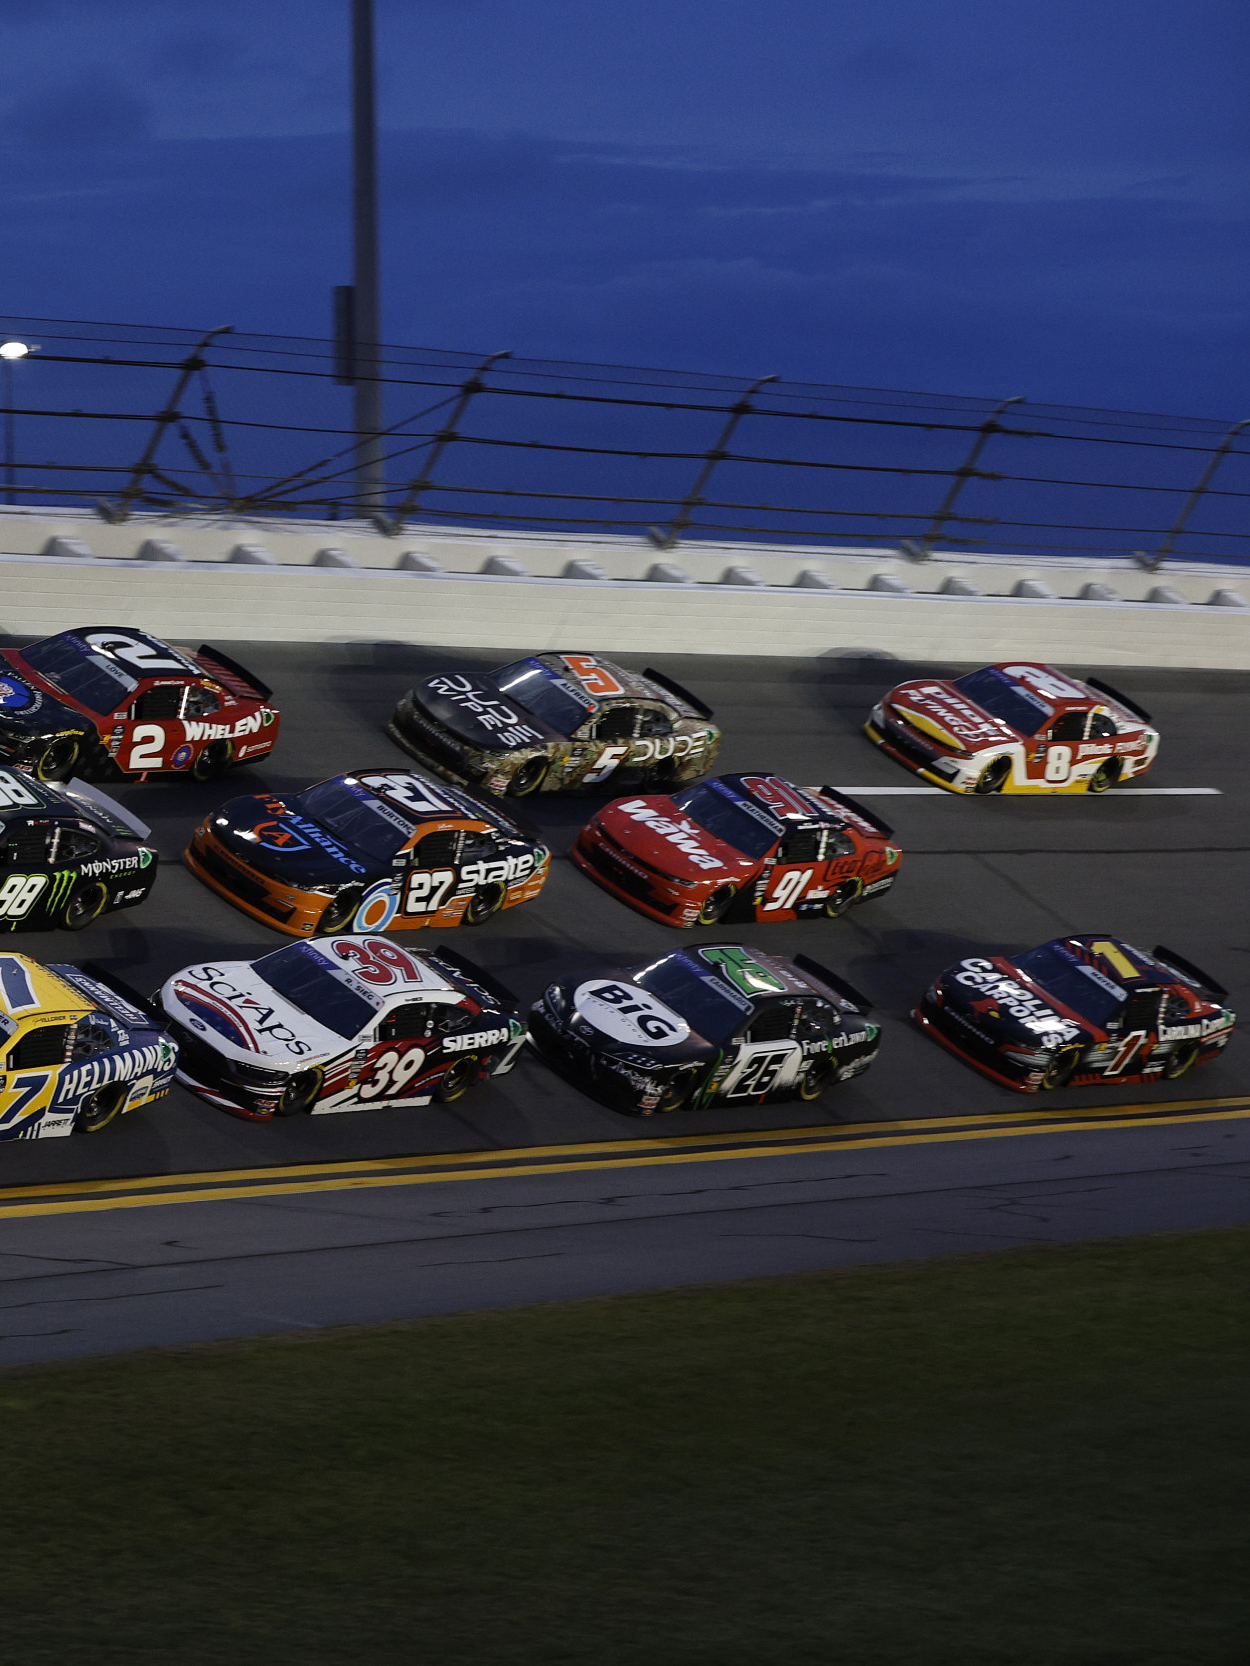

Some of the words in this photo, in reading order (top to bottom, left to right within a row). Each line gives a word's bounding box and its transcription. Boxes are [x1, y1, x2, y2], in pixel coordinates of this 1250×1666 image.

[85, 633, 189, 670] 2
[106, 664, 126, 679] LOVE
[559, 655, 625, 695] 5
[1002, 665, 1087, 699] 8
[182, 711, 262, 741] WHELEN
[427, 678, 522, 747] WIPES
[440, 674, 545, 743] DUDE
[129, 724, 165, 769] 2
[582, 745, 632, 784] 5
[632, 730, 708, 762] DUDE
[1045, 745, 1072, 781] 8
[357, 773, 459, 816] 27
[739, 776, 819, 820] 91
[376, 805, 410, 831] BURTON
[617, 800, 724, 870] Wawa
[457, 854, 535, 889] state
[763, 869, 814, 911] 91
[403, 868, 457, 918] 27
[331, 938, 423, 986] 39
[1090, 941, 1142, 979] 1
[188, 966, 311, 1055] SciAps
[354, 985, 374, 1001] SIEG
[954, 971, 1064, 1049] CARPOS
[442, 1028, 509, 1053] SIERRA
[1102, 1030, 1149, 1076] 1
[58, 1042, 180, 1104] HELLMANNS
[359, 1047, 426, 1099] 39
[727, 1047, 798, 1098] 26
